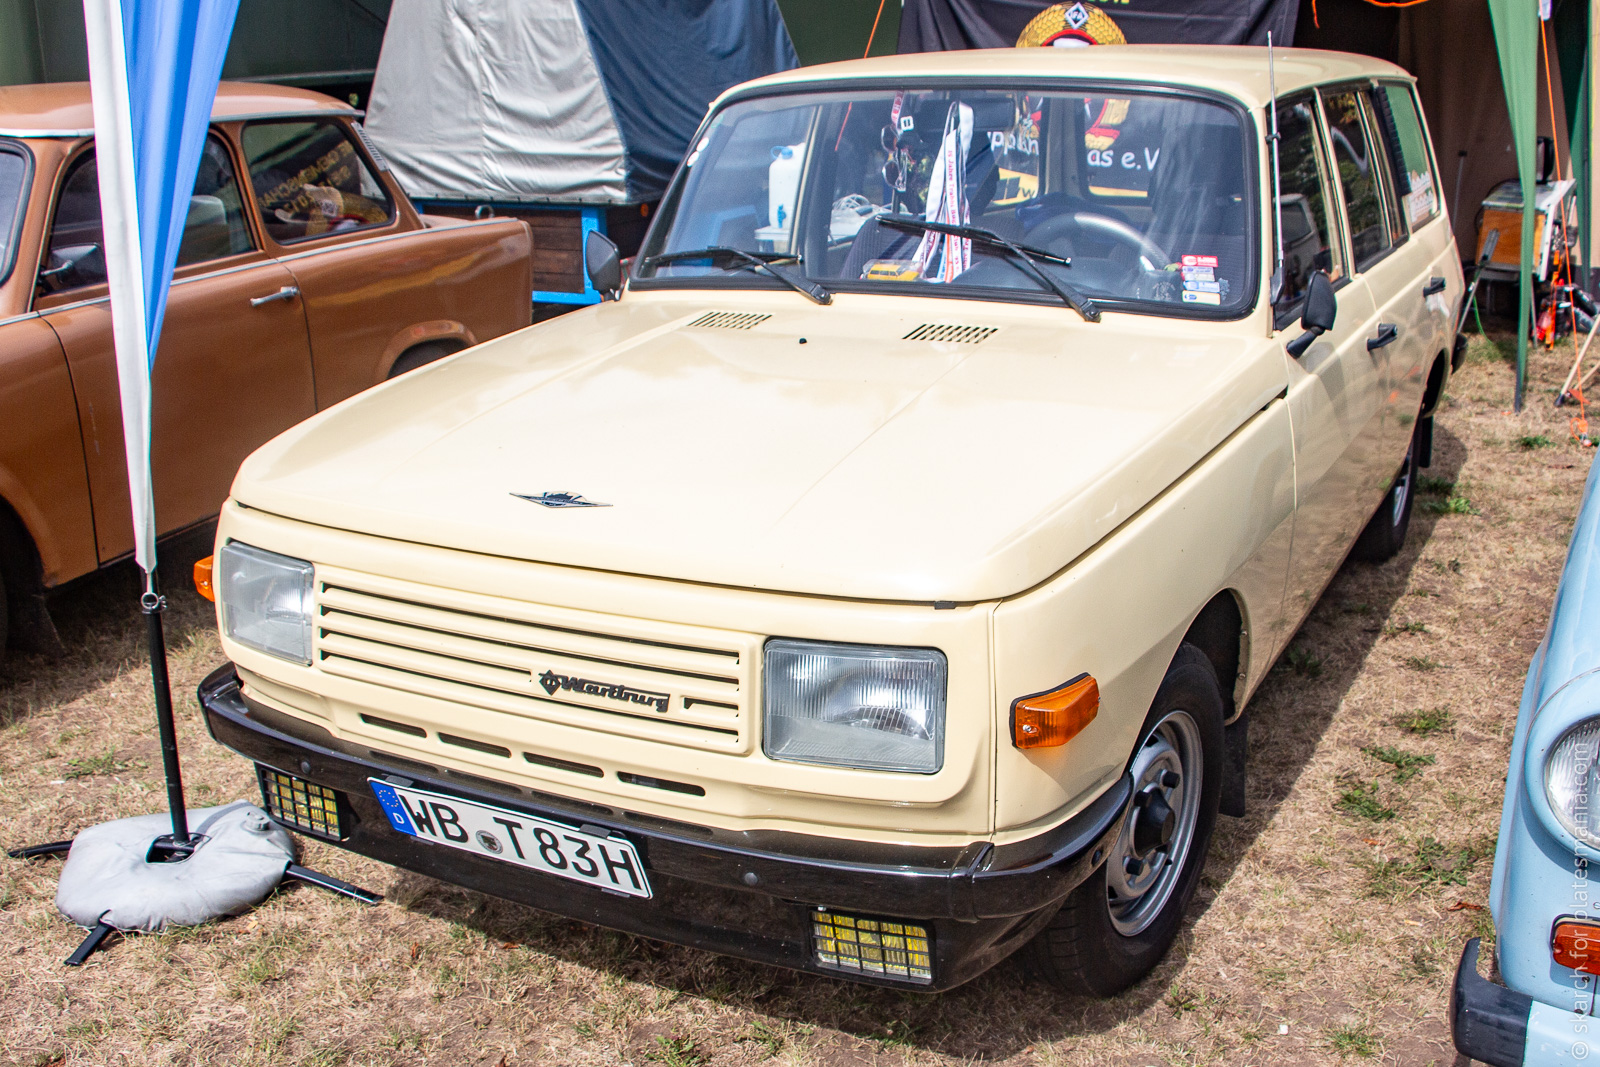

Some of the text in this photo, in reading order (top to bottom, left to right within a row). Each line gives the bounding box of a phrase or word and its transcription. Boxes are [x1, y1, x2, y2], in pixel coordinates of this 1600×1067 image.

[555, 673, 671, 713] Wartburg
[393, 812, 405, 825] D
[397, 793, 470, 844] WB
